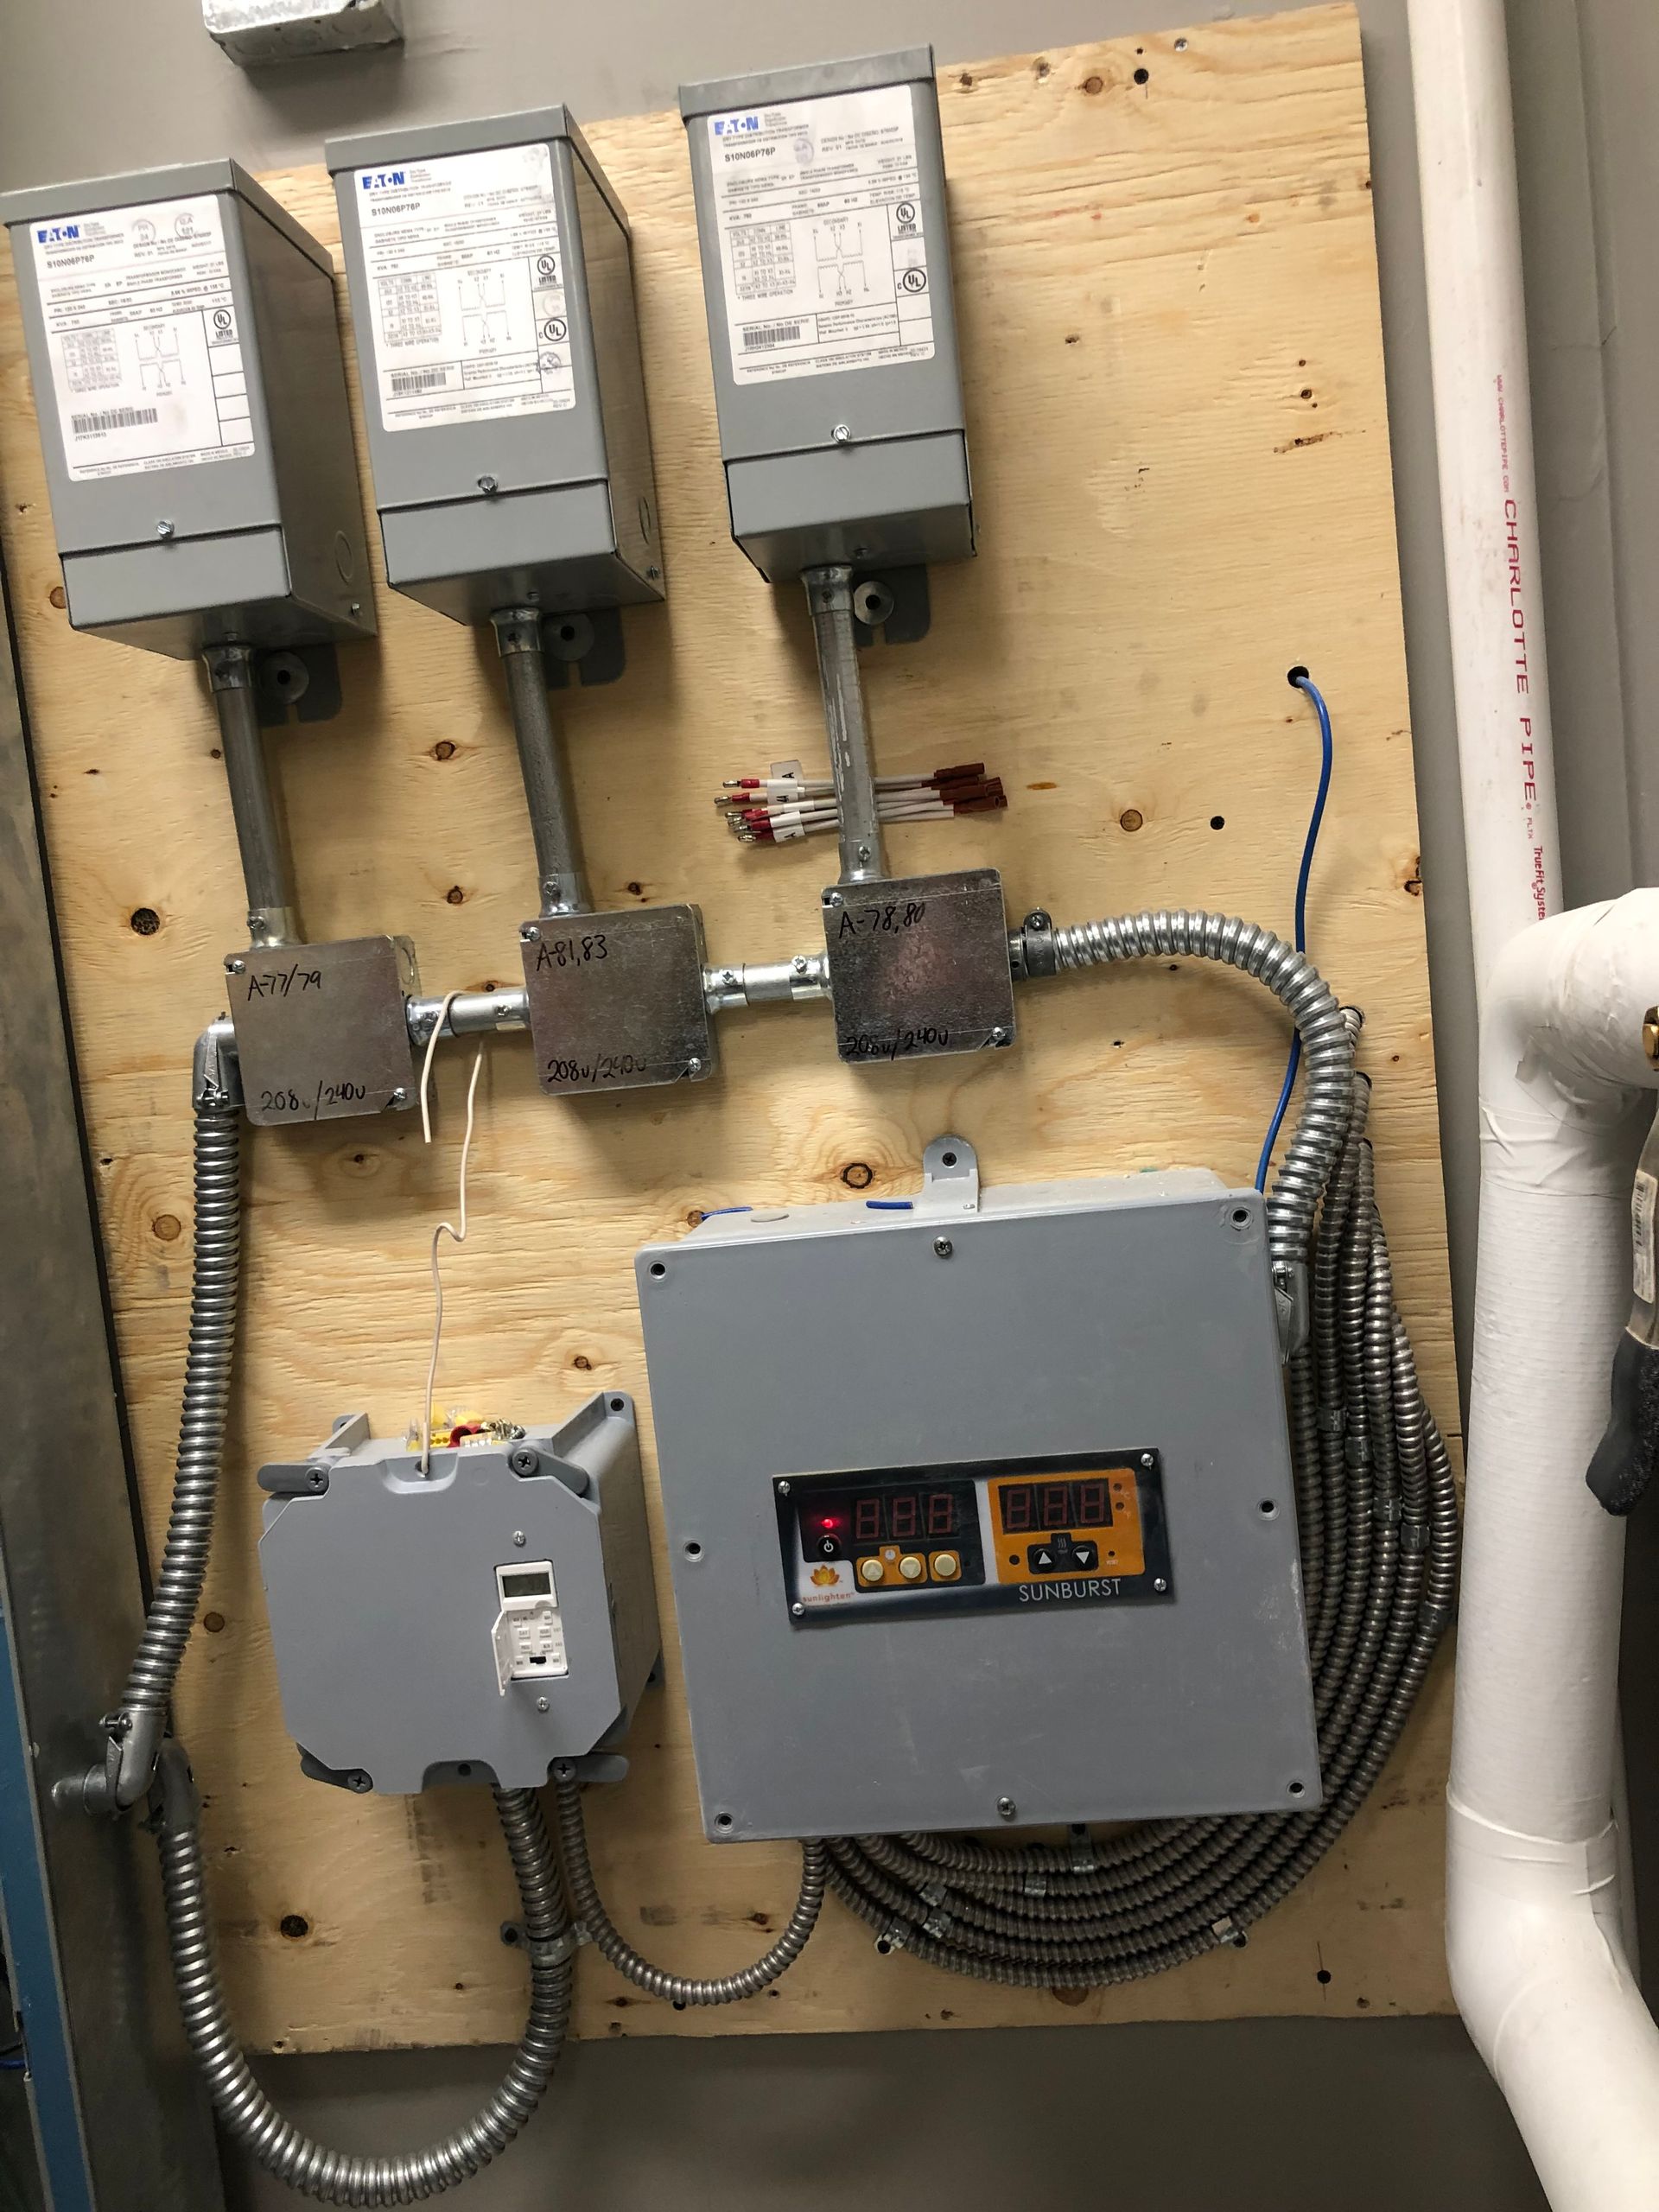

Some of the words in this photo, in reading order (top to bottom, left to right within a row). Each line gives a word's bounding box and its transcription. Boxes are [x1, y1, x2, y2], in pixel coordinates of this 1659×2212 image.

[715, 117, 759, 136] EATON
[725, 147, 776, 162] S10N06P76P
[362, 171, 405, 190] EATON
[372, 202, 420, 217] S10N06P76P
[37, 225, 79, 244] EATON
[1504, 499, 1529, 694] CHARLOTTE
[1533, 887, 1547, 921] Syste
[1019, 1578, 1122, 1603] SUNBURST
